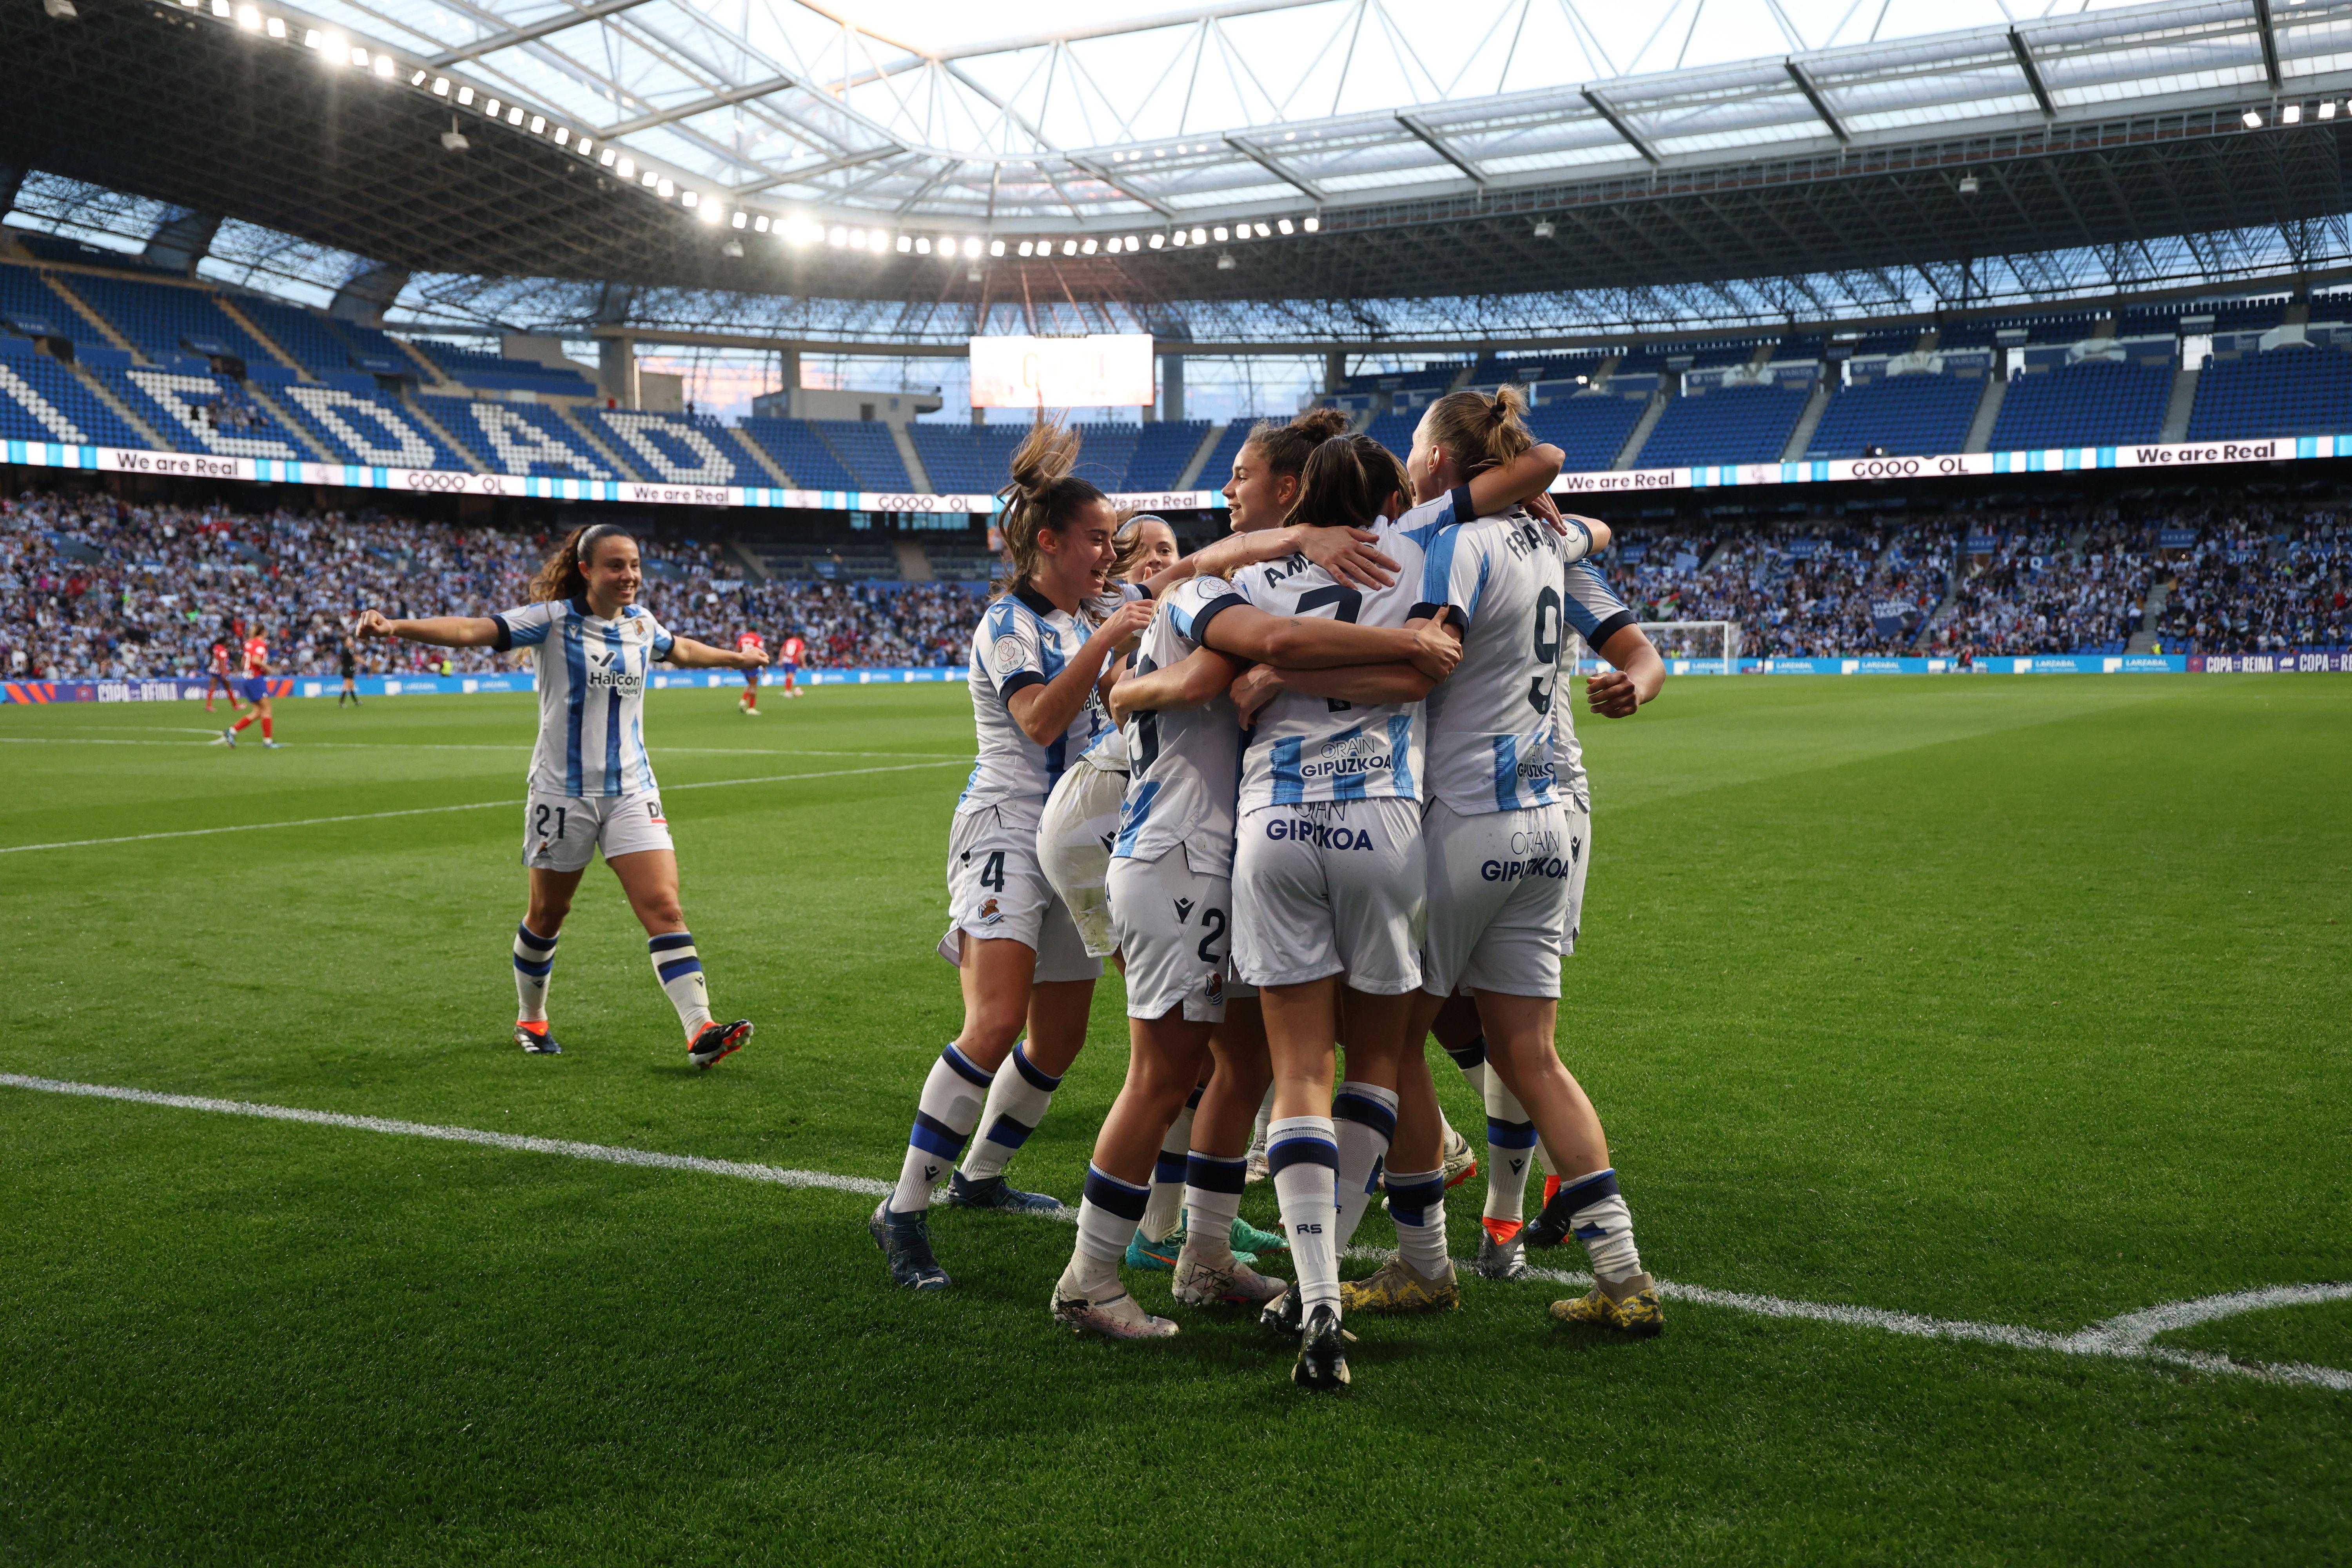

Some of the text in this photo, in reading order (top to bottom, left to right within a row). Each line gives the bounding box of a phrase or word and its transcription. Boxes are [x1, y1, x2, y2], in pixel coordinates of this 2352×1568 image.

[2136, 442, 2276, 464] We are Real
[117, 453, 238, 476] We are Real
[1567, 470, 1675, 490] We are Real
[634, 486, 729, 503] We are Real
[1163, 494, 1197, 507] Real
[1528, 586, 1561, 715] 9
[2206, 656, 2233, 673] COPA
[2241, 655, 2273, 673] REINA
[2300, 653, 2329, 672] COPA
[590, 672, 640, 686] Halcón
[1321, 739, 1375, 758] ORAIN
[1301, 754, 1392, 777] GIPUZKOA
[536, 804, 565, 839] 21
[980, 851, 1005, 892] 4
[1296, 1223, 1322, 1235] RS
